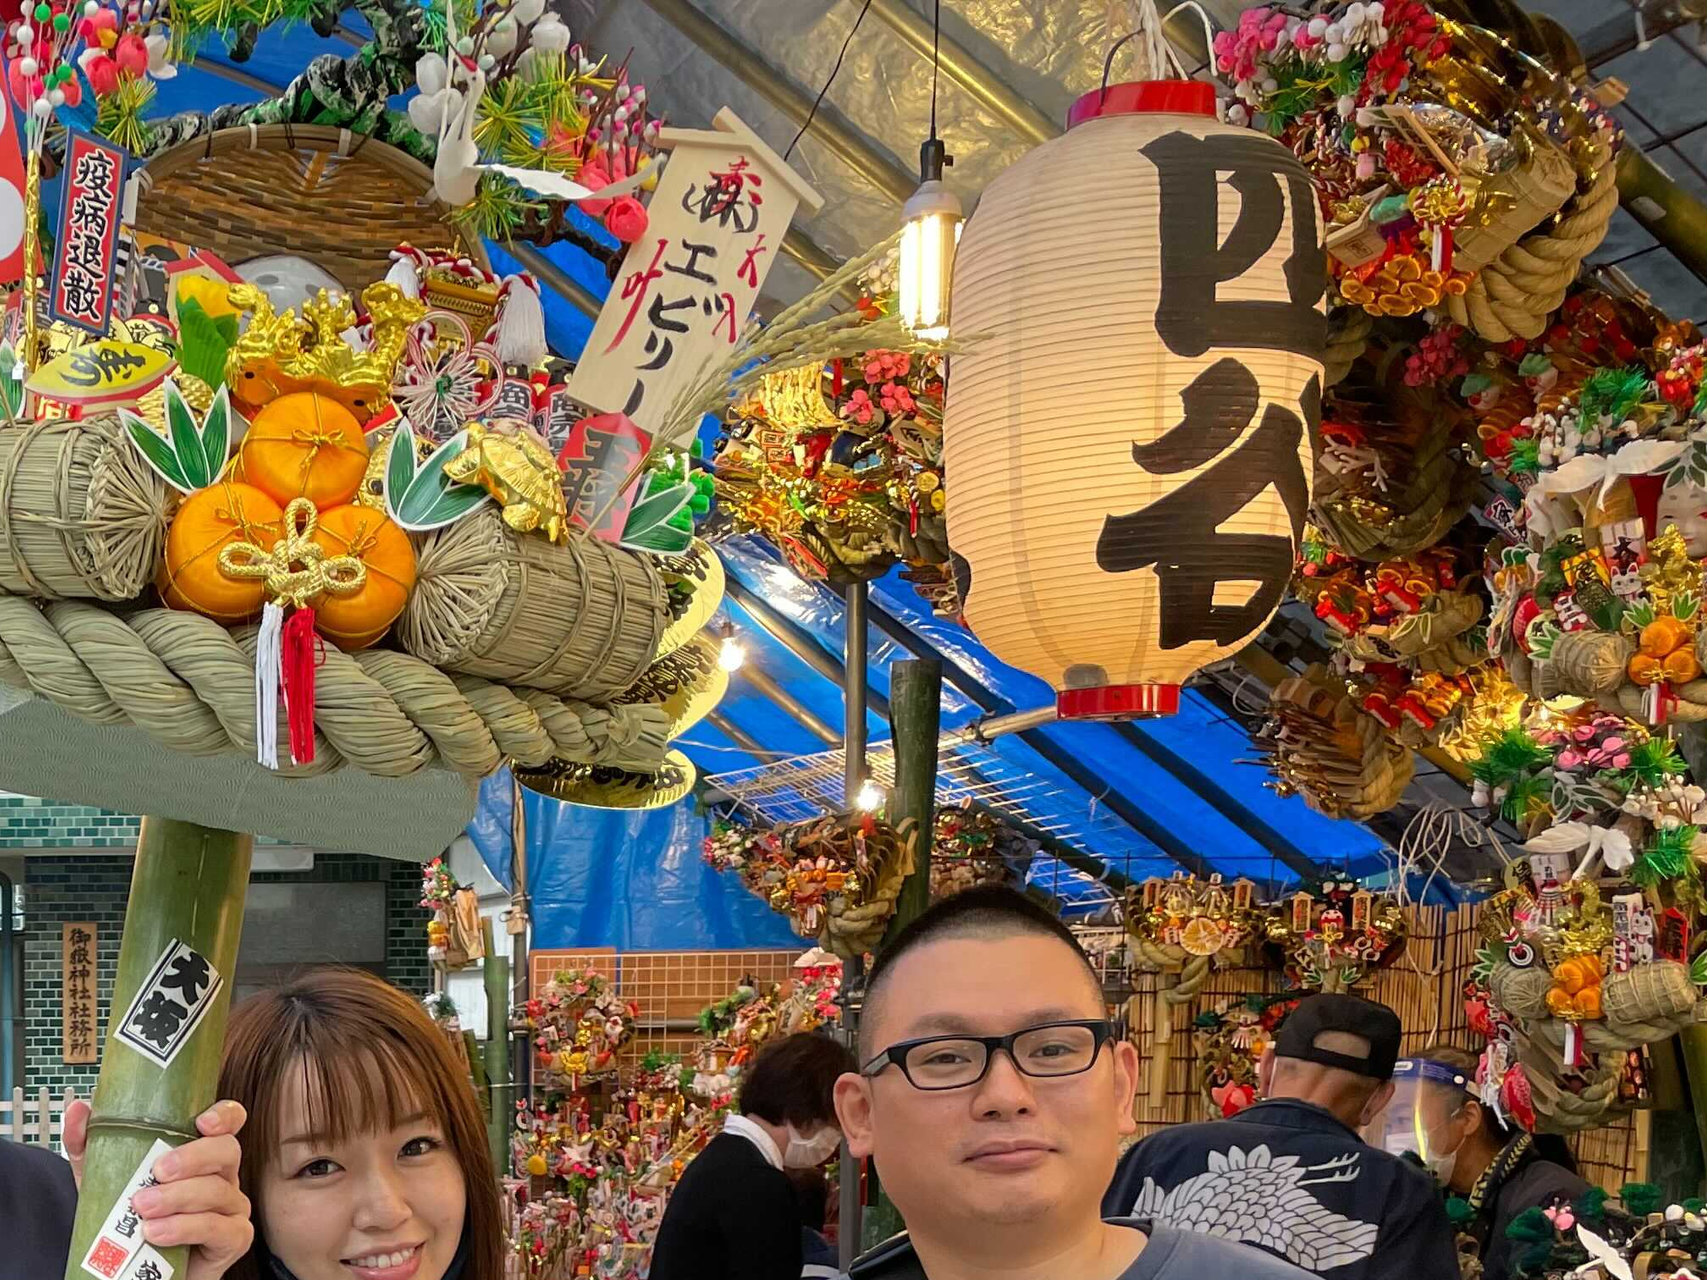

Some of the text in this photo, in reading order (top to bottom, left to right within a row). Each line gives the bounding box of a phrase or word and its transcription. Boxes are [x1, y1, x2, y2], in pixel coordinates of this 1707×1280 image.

[61, 148, 116, 322] 疫病退散
[67, 927, 93, 1057] 御嶽神社社務所
